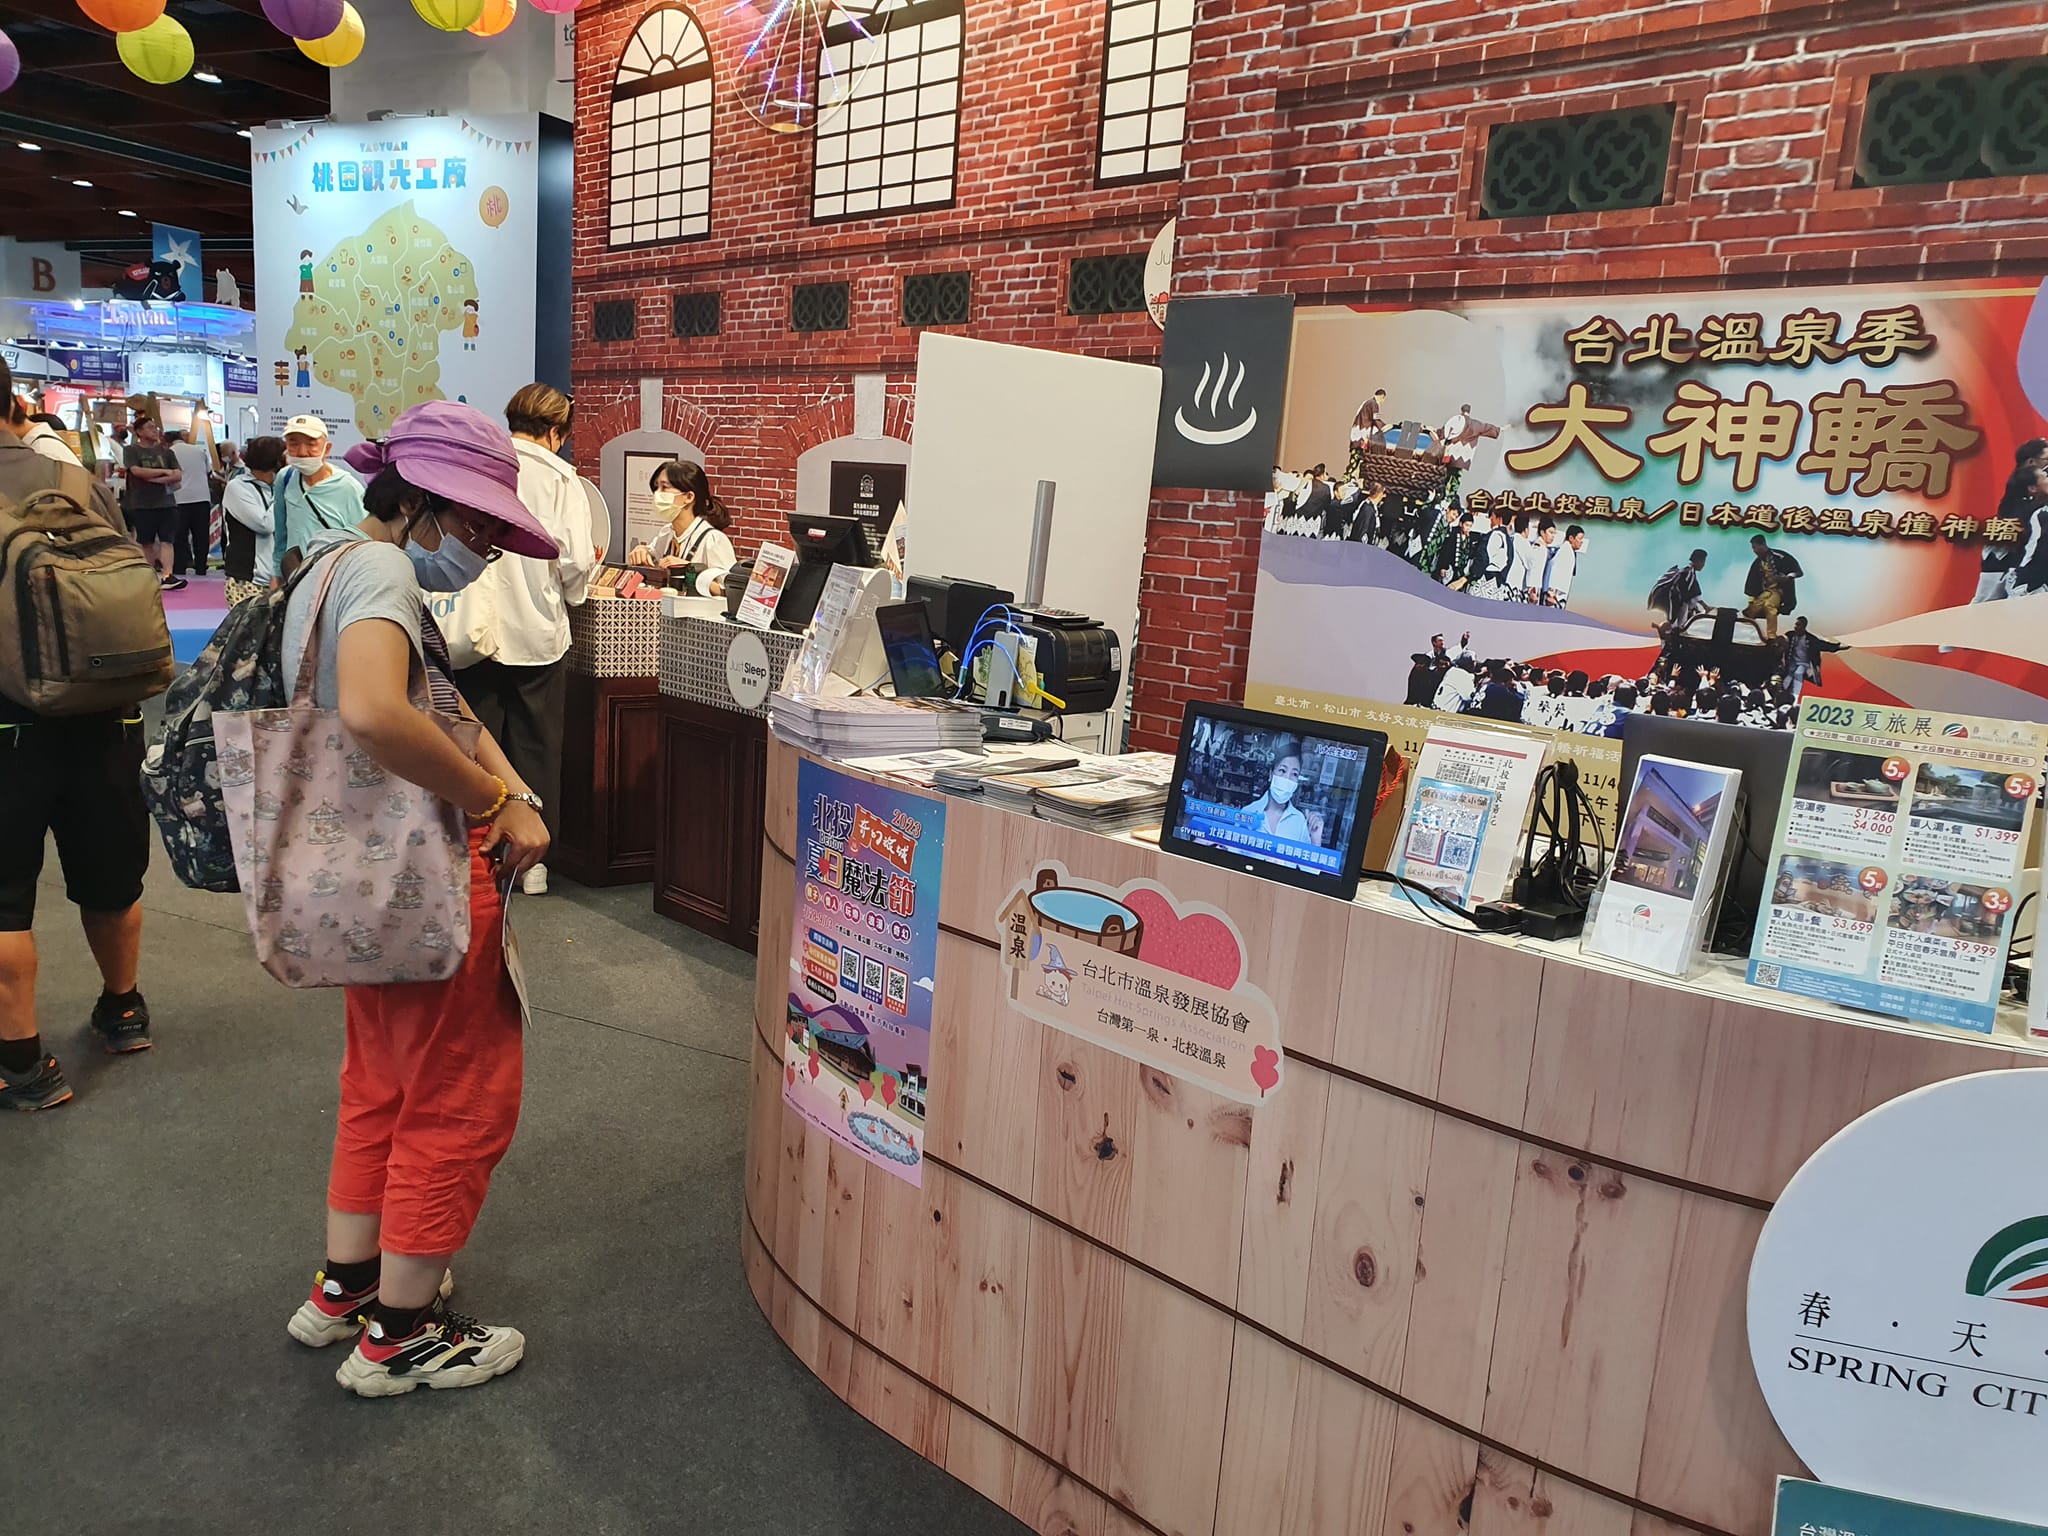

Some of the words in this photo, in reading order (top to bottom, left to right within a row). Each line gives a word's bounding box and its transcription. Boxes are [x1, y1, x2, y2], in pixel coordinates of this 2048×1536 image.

[311, 156, 467, 192] 桃園觀光工廠
[31, 256, 57, 292] B
[1568, 306, 1937, 368] 台北溫泉季
[1505, 378, 1983, 498] 大神轎
[744, 662, 767, 680] Sleep
[1806, 703, 1855, 727] 2023
[811, 792, 854, 843] 北投
[892, 808, 923, 838] 2023
[1974, 827, 2019, 843] $1,399
[805, 837, 917, 918] 夏日魔法節
[1081, 958, 1252, 1034] 台北市溫泉發展協會
[1114, 992, 1134, 1010] Hot
[1787, 1345, 1950, 1399] SPRING
